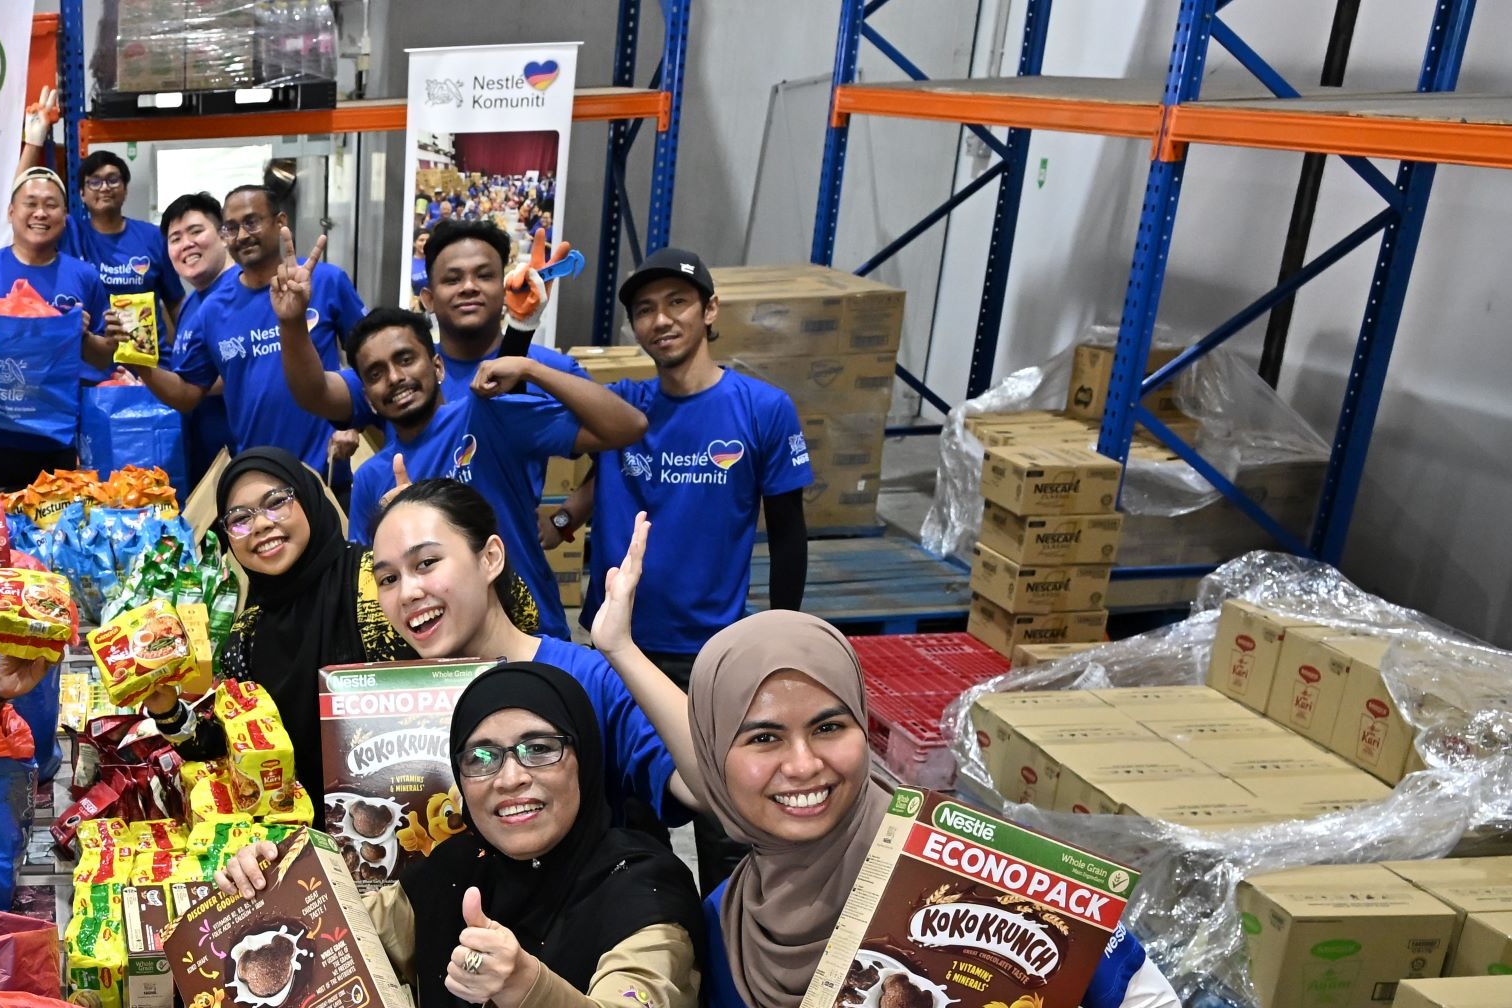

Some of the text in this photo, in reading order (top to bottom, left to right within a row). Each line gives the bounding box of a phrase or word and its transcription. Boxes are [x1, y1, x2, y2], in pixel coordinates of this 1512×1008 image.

[472, 74, 524, 91] Nestlé
[472, 92, 545, 109] Komuniti
[250, 328, 281, 342] Nest
[252, 342, 282, 357] Kom
[661, 449, 708, 467] Nestlé
[660, 470, 727, 485] Komuniti
[432, 671, 453, 679] Whole
[454, 670, 473, 678] Grain
[331, 689, 460, 715] ECONO PAC
[1294, 696, 1312, 712] Kari
[396, 734, 450, 759] KRUNC
[1362, 731, 1380, 748] Kari
[397, 774, 424, 784] VITAMINS
[1061, 853, 1086, 868] Whole
[1086, 863, 1108, 877] Grain
[922, 832, 1110, 921] ECONO PACK
[301, 893, 329, 916] CHOCOLATEY
[304, 890, 319, 904] GREAT
[187, 895, 218, 923] DISCOVER
[310, 908, 324, 921] TASTE
[921, 908, 1057, 972] KOKO KRUNCH
[946, 971, 951, 980] &
[959, 962, 994, 982] VITAMINS
[979, 952, 1012, 972] CHOCOLATEY
[1012, 967, 1031, 985] TASTE
